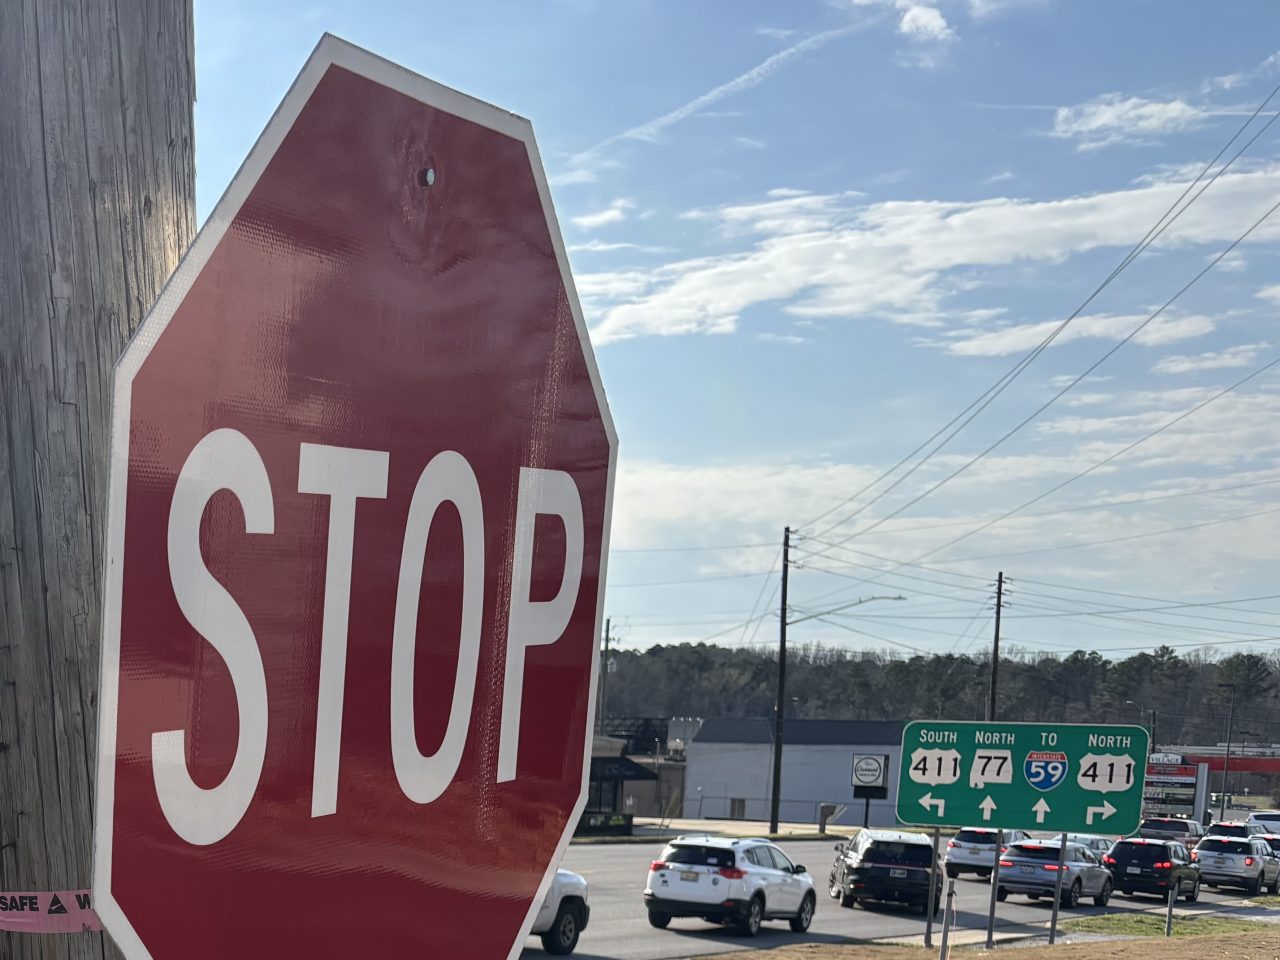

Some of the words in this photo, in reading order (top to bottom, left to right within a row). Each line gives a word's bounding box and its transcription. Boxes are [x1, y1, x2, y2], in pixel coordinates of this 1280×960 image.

[151, 427, 585, 846] STOP
[919, 729, 958, 744] SOUTH
[975, 730, 1016, 745] NORTH
[1040, 732, 1058, 746] TO
[1087, 733, 1131, 748] NORTH
[912, 755, 959, 778] 411
[977, 755, 1009, 777] 77
[1029, 761, 1063, 783] 59
[1081, 761, 1133, 785] 411
[0, 895, 40, 912] SAFE
